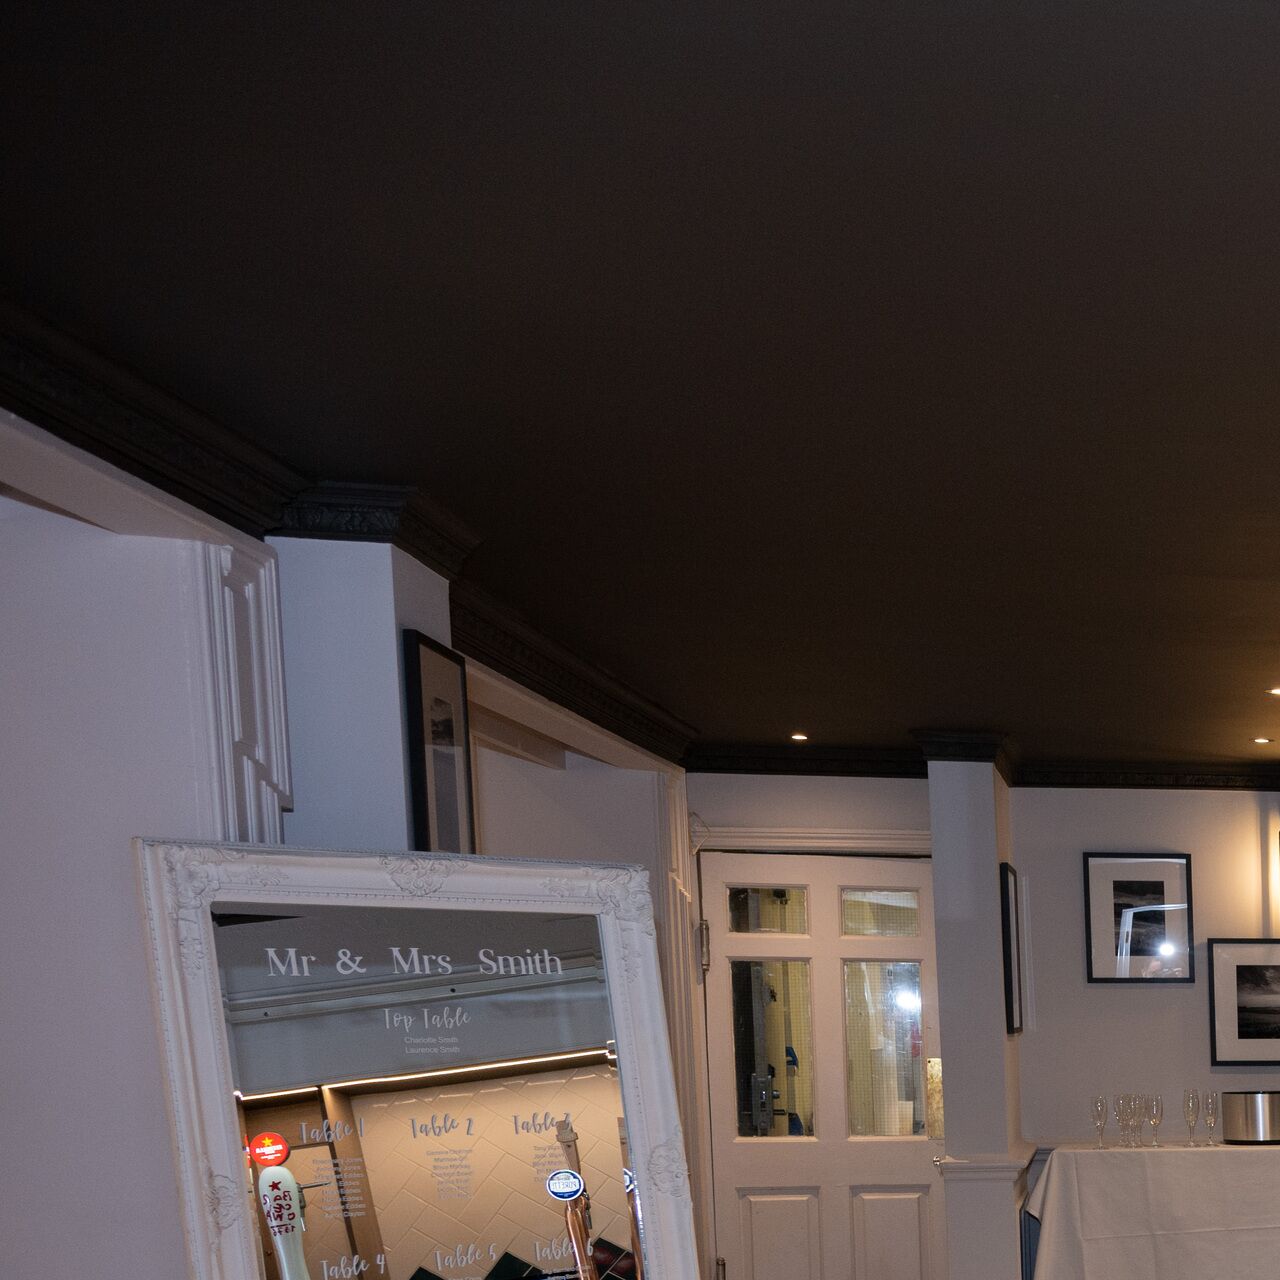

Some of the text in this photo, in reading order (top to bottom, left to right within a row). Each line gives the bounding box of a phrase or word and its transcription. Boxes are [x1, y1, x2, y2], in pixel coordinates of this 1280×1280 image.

[264, 947, 563, 977] Mr & Mrs Smith
[383, 1007, 472, 1032] Top Table
[438, 1036, 458, 1044] Smith
[297, 1117, 365, 1144] Table 1
[409, 1113, 474, 1139] Table 2
[513, 1112, 559, 1135] Table
[433, 1243, 497, 1271] Table 5
[534, 1237, 575, 1261] Table
[320, 1254, 385, 1280] Table 4
